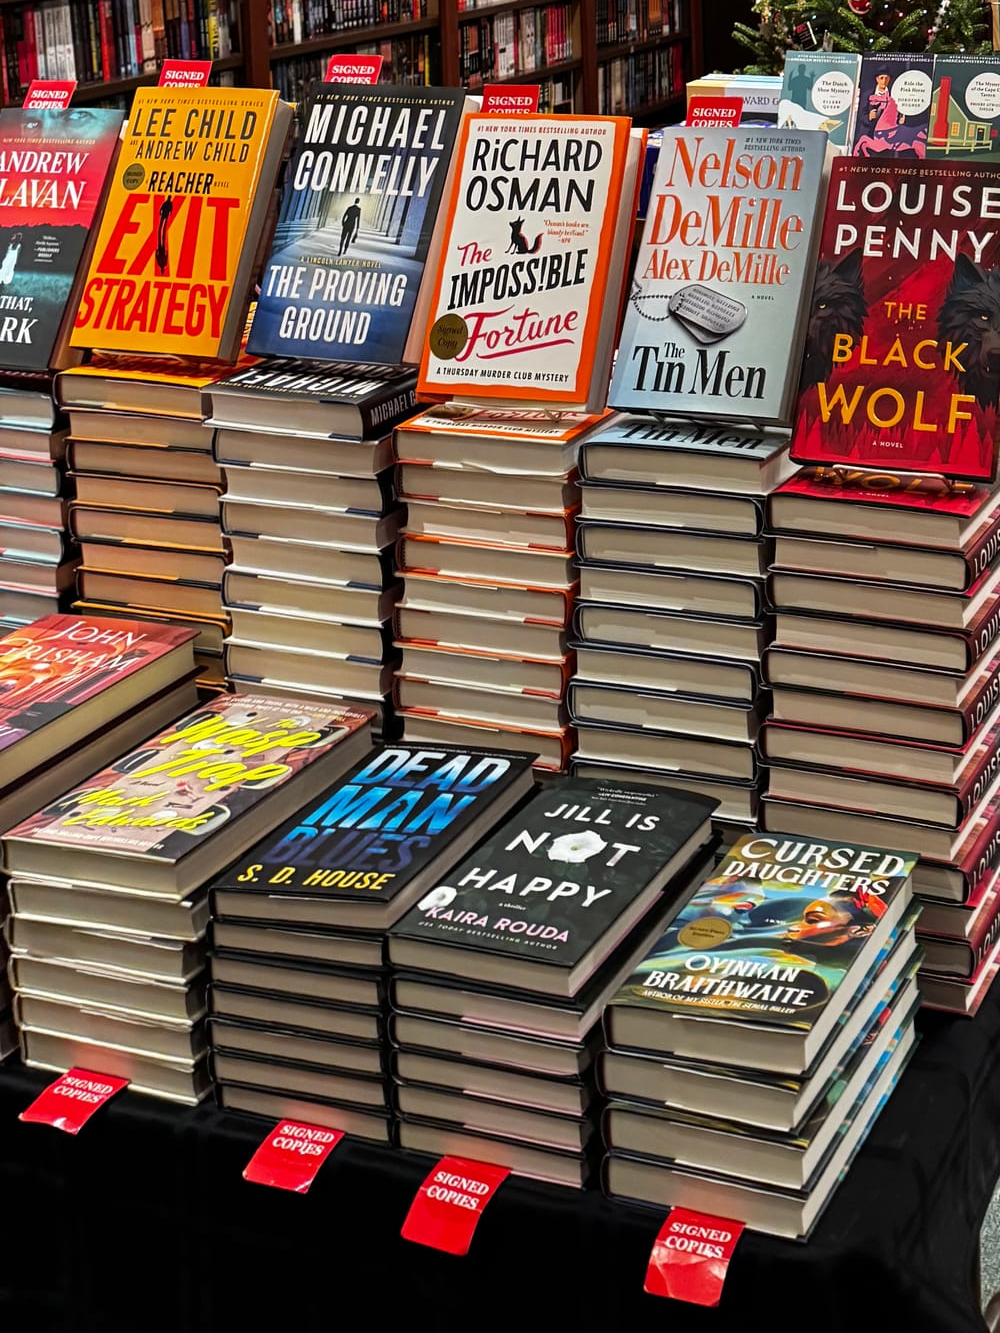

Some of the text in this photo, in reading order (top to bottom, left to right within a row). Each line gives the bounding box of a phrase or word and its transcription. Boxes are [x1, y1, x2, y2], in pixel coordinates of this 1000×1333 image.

[164, 70, 204, 80] SIGNED
[332, 65, 375, 75] SIGNED
[28, 101, 64, 109] COPIES
[31, 89, 68, 100] SIGNED
[488, 96, 533, 106] SIGNED
[132, 108, 257, 140] LEE CHILD
[304, 104, 446, 150] MICHAEL
[692, 108, 737, 117] SIGNED
[692, 120, 733, 128] COPIES
[539, 127, 579, 135] BESTSELLING
[135, 141, 249, 163] ANDREW CHILD
[665, 137, 804, 190] Nelson
[148, 171, 214, 195] REACHER
[293, 150, 439, 198] CONNELLY
[850, 166, 868, 174] NEW
[919, 169, 971, 178] BESTSELLING
[465, 175, 595, 213] OSMAN
[96, 193, 240, 281] EXIT
[646, 194, 803, 251] DeMille
[457, 241, 492, 266] The
[834, 224, 994, 264] PENNY
[642, 248, 791, 286] Alex DeMille
[266, 265, 408, 306] THE PROVING
[73, 277, 229, 338] STRATEGY
[884, 301, 927, 320] THE
[279, 306, 371, 345] GROUND
[455, 304, 579, 362] Fortune
[664, 342, 685, 358] The
[831, 333, 969, 372] BLACK
[443, 367, 478, 377] THURSDAY
[480, 370, 511, 379] MURDER
[514, 371, 532, 380] CLUB
[534, 373, 569, 383] MYSTERY
[632, 346, 767, 400] Tin Men
[817, 382, 976, 434] WOLF
[45, 621, 148, 649] JOHN
[160, 715, 321, 758] Wasp
[129, 748, 289, 792] Trap
[350, 749, 511, 794] DEAD
[301, 784, 478, 836] MAN
[544, 803, 660, 831] JILL IS
[260, 825, 432, 873] BLUES
[741, 837, 905, 878] CURSED
[237, 864, 396, 891] S. D. HOUSE
[457, 867, 612, 909] HAPPY
[722, 860, 890, 896] DAUGHTERS
[425, 906, 569, 944] KAIRA ROUDA
[685, 954, 801, 983] OYINKAN
[643, 971, 815, 1007] BRAITHWAITE
[53, 1084, 103, 1104] COPIES
[62, 1075, 113, 1095] SIGNED
[272, 1138, 325, 1156] COPIES
[279, 1125, 335, 1144] SIGNED
[433, 1170, 489, 1196] SIGNED
[426, 1185, 479, 1211] COPIES
[669, 1221, 732, 1243] SIGNED
[664, 1236, 725, 1259] COPIES
